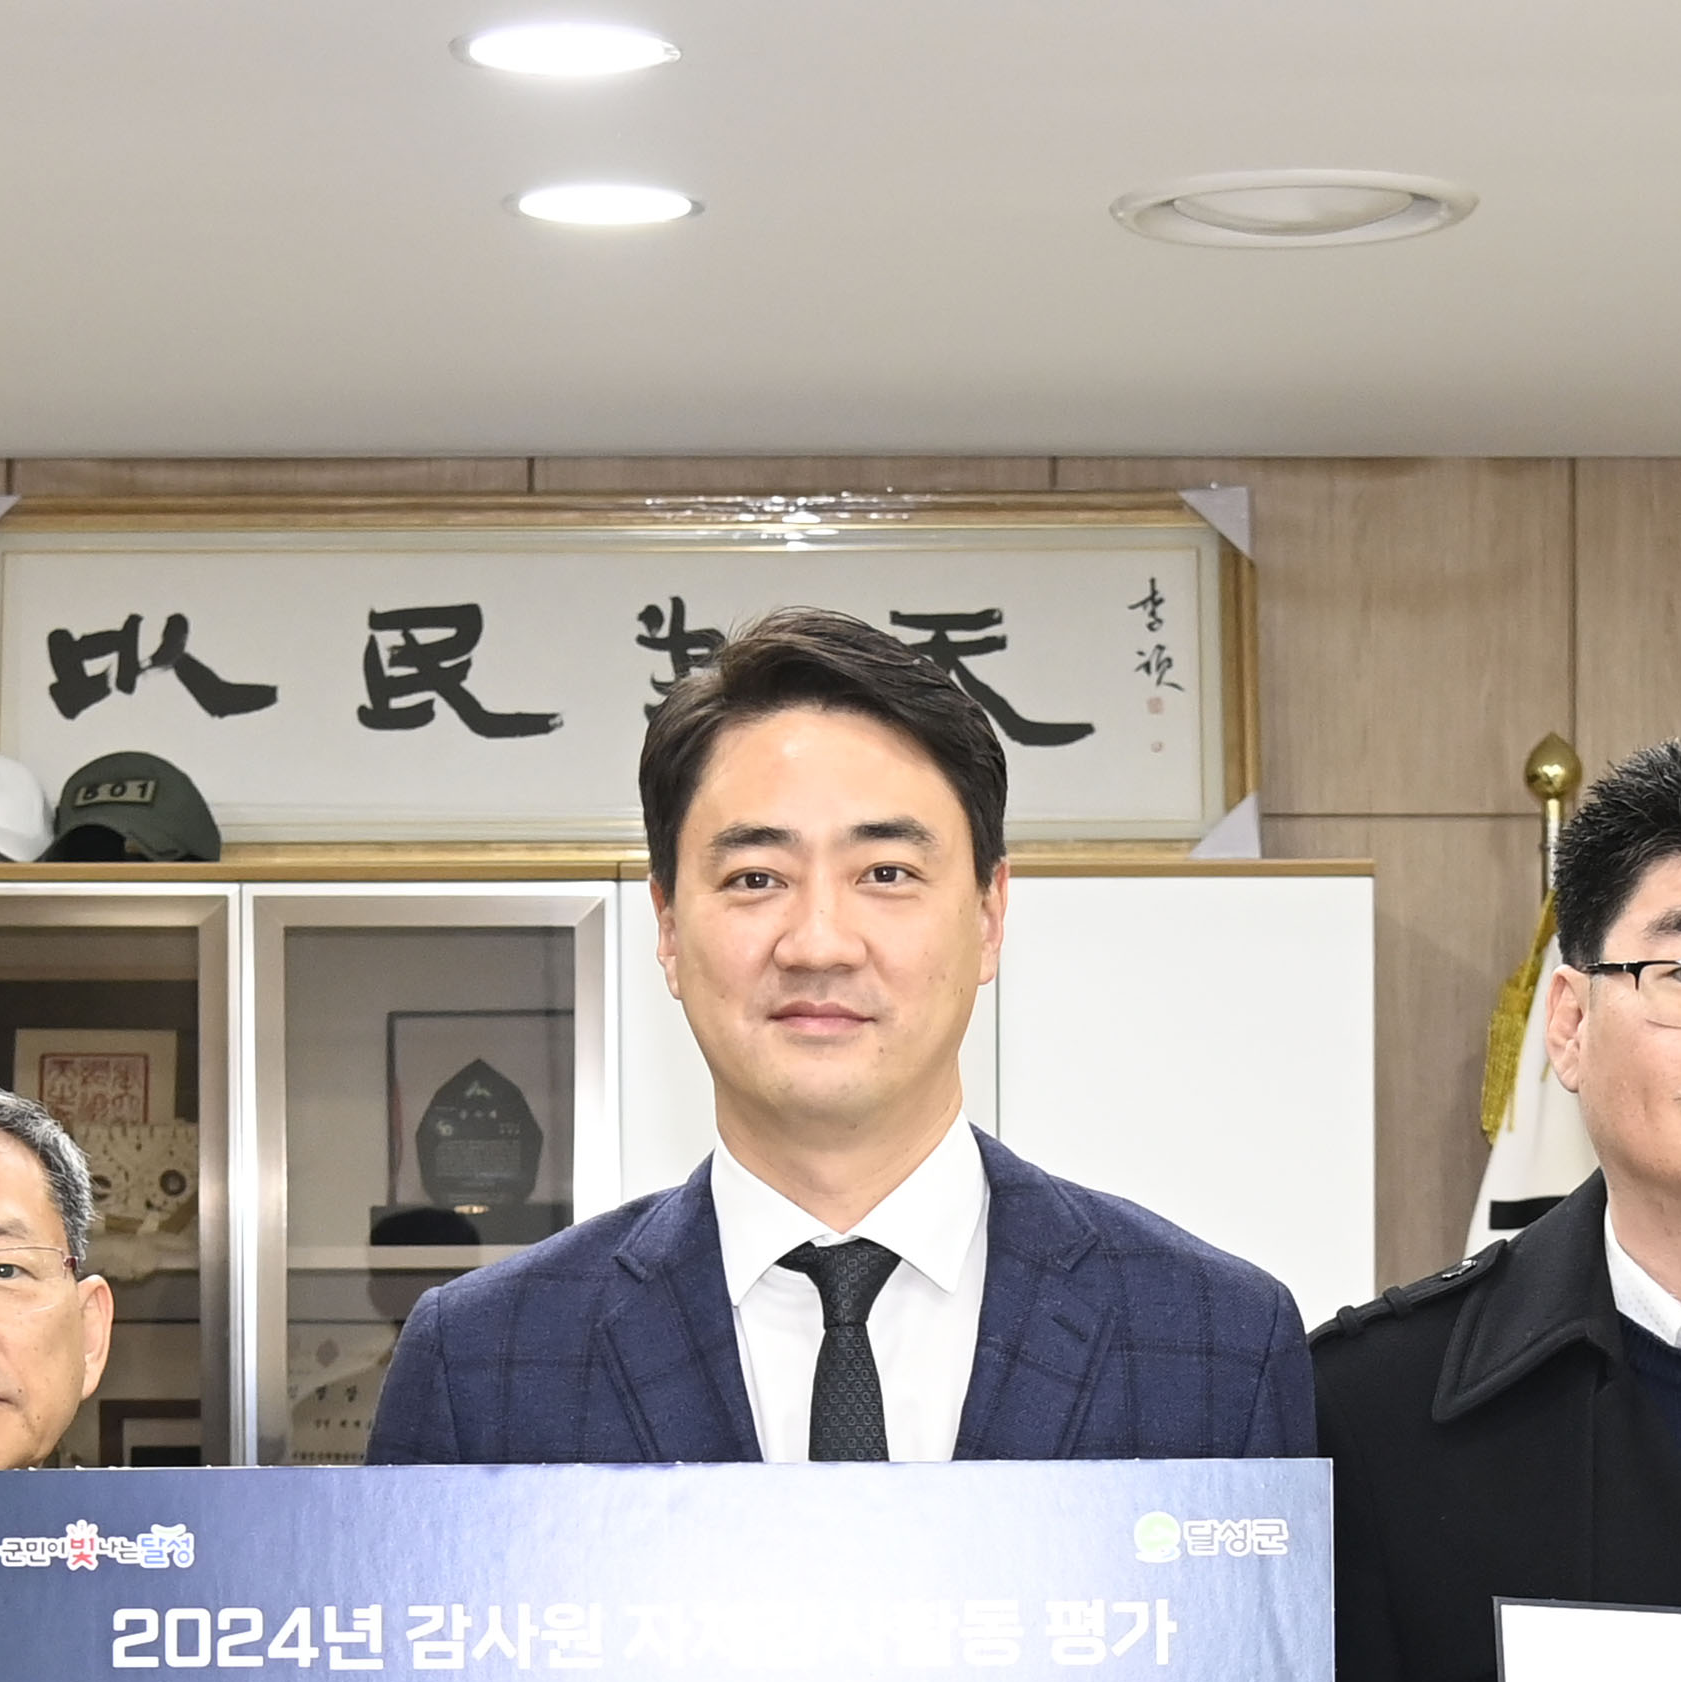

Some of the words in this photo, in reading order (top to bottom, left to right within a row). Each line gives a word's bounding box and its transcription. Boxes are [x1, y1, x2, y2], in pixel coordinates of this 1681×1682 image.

[1182, 1517, 1289, 1557] 달성군
[111, 1603, 385, 1670] 2024년
[405, 1602, 606, 1670] 감사원
[620, 1598, 1026, 1668] 자사동
[1045, 1598, 1178, 1667] 평가
